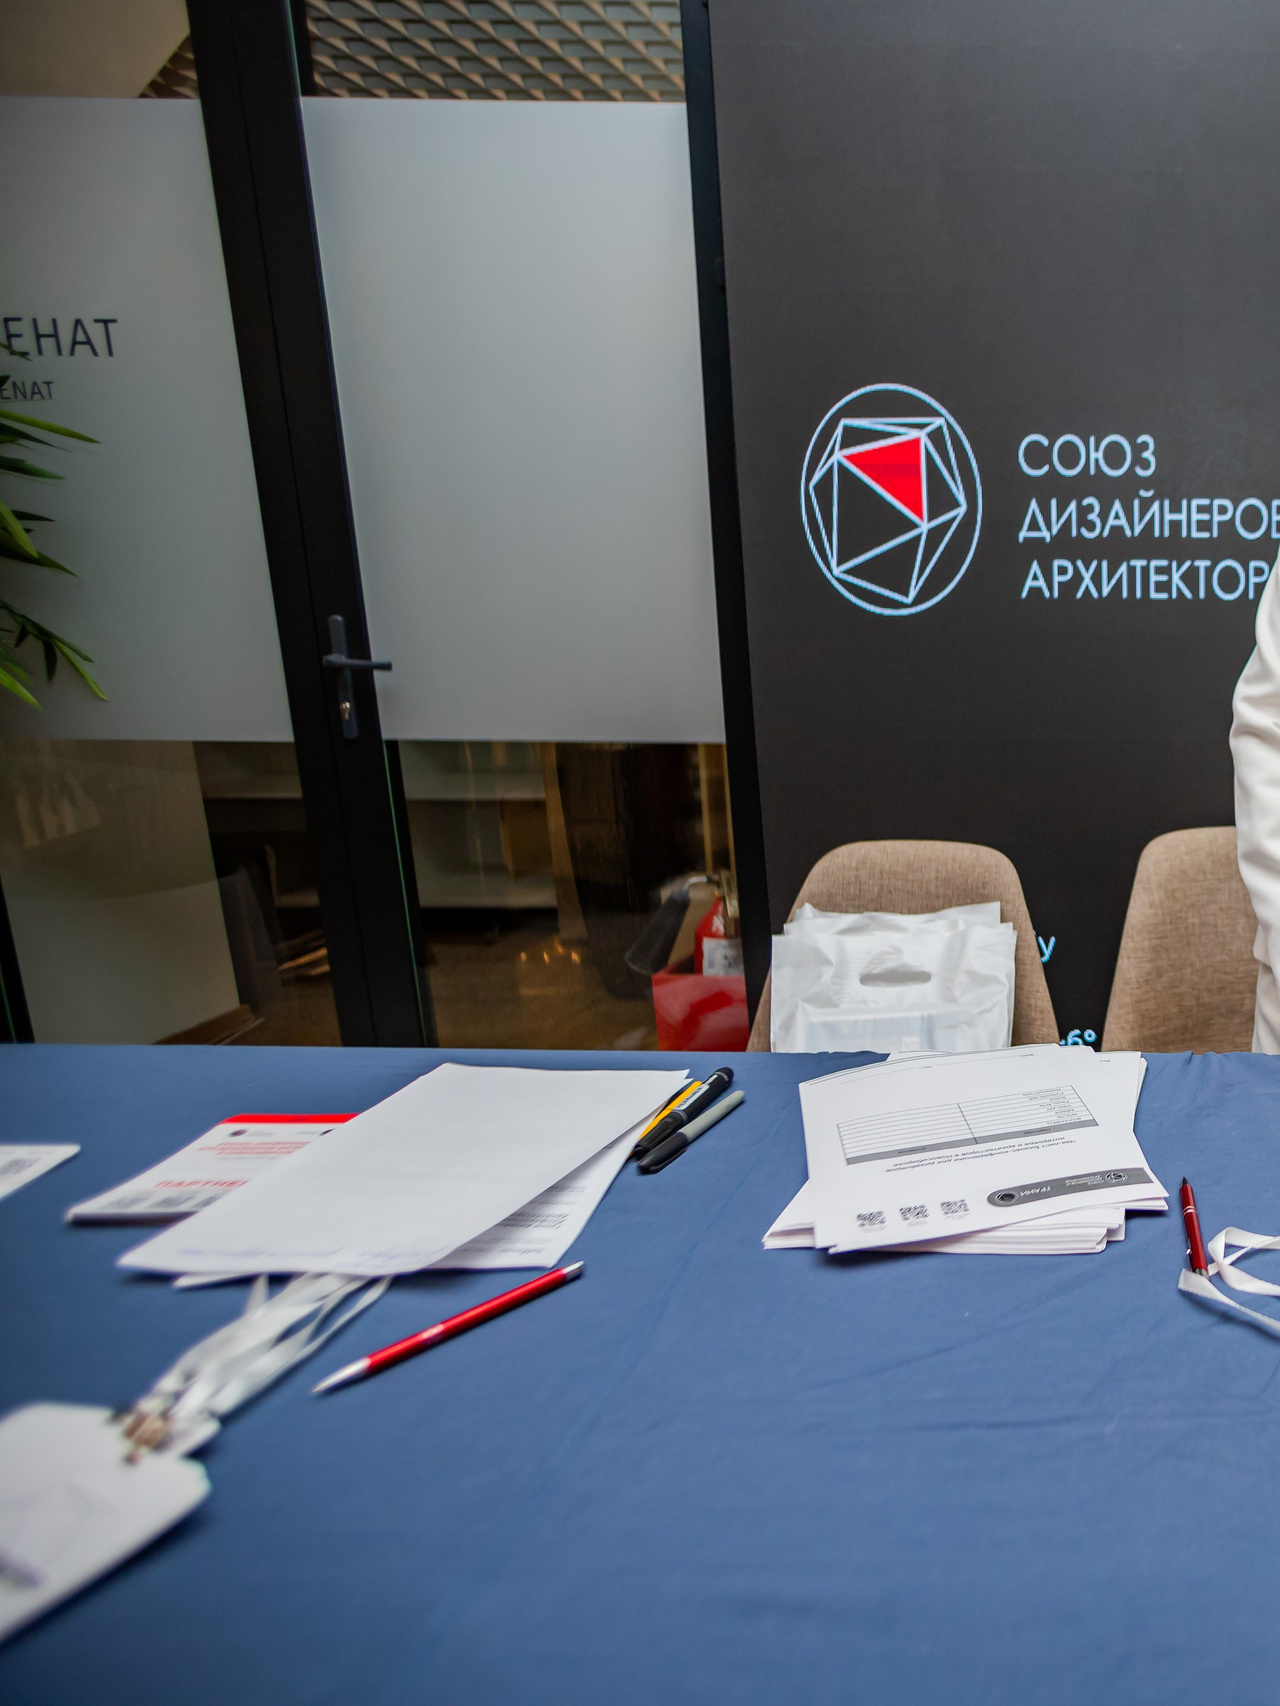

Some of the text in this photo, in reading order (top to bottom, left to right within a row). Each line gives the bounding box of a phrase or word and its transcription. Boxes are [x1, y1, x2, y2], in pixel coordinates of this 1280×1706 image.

[3, 317, 118, 357] ЕНАТ
[0, 381, 54, 400] ENAT
[1018, 434, 1157, 477] СОЮЗ
[1021, 559, 1270, 600] АРХИТЕКТОР
